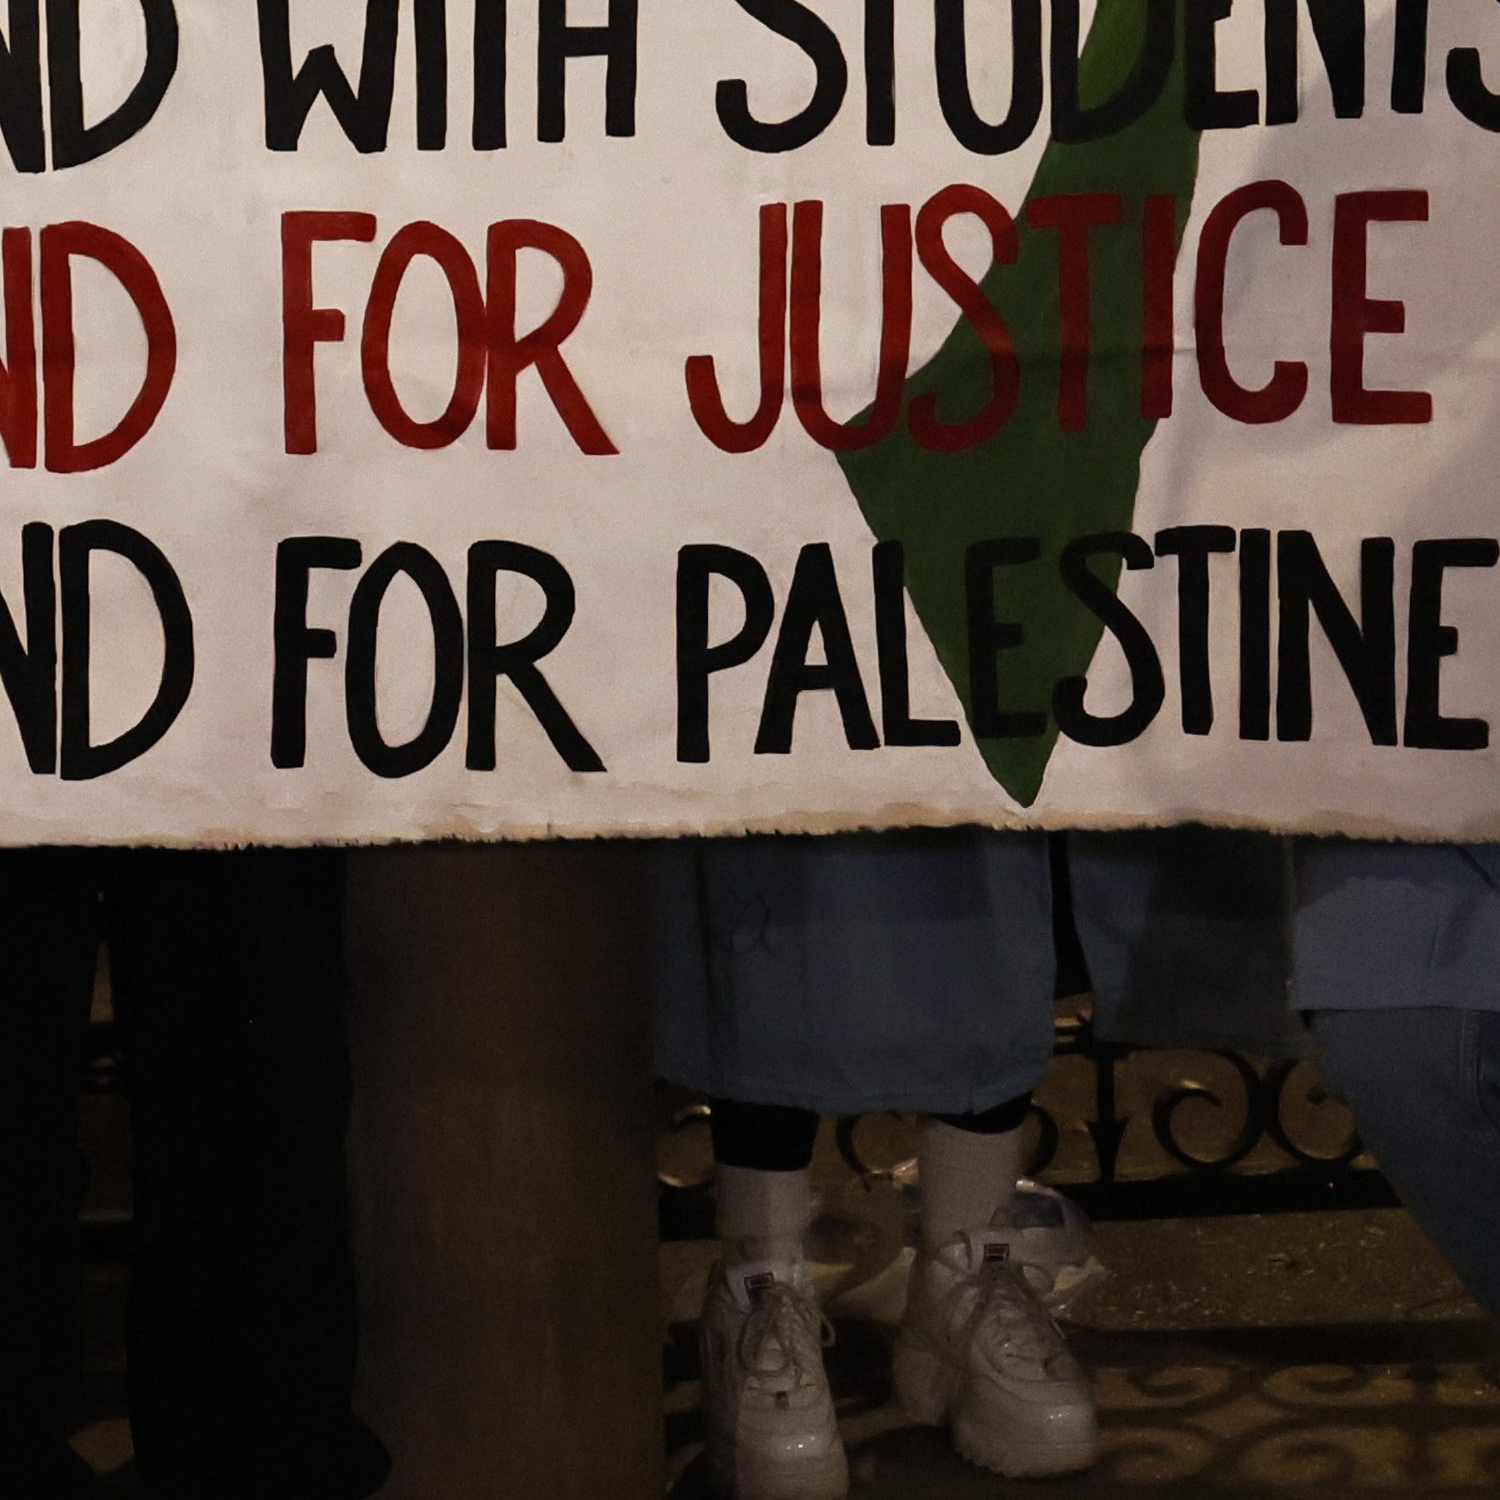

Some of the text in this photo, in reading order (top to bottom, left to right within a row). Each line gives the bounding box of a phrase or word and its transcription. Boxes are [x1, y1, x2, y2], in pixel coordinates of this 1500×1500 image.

[281, 210, 619, 455] FOR
[685, 180, 1433, 453] JUSTICE
[270, 537, 607, 778] FOR
[675, 525, 1499, 763] PALESTINE
